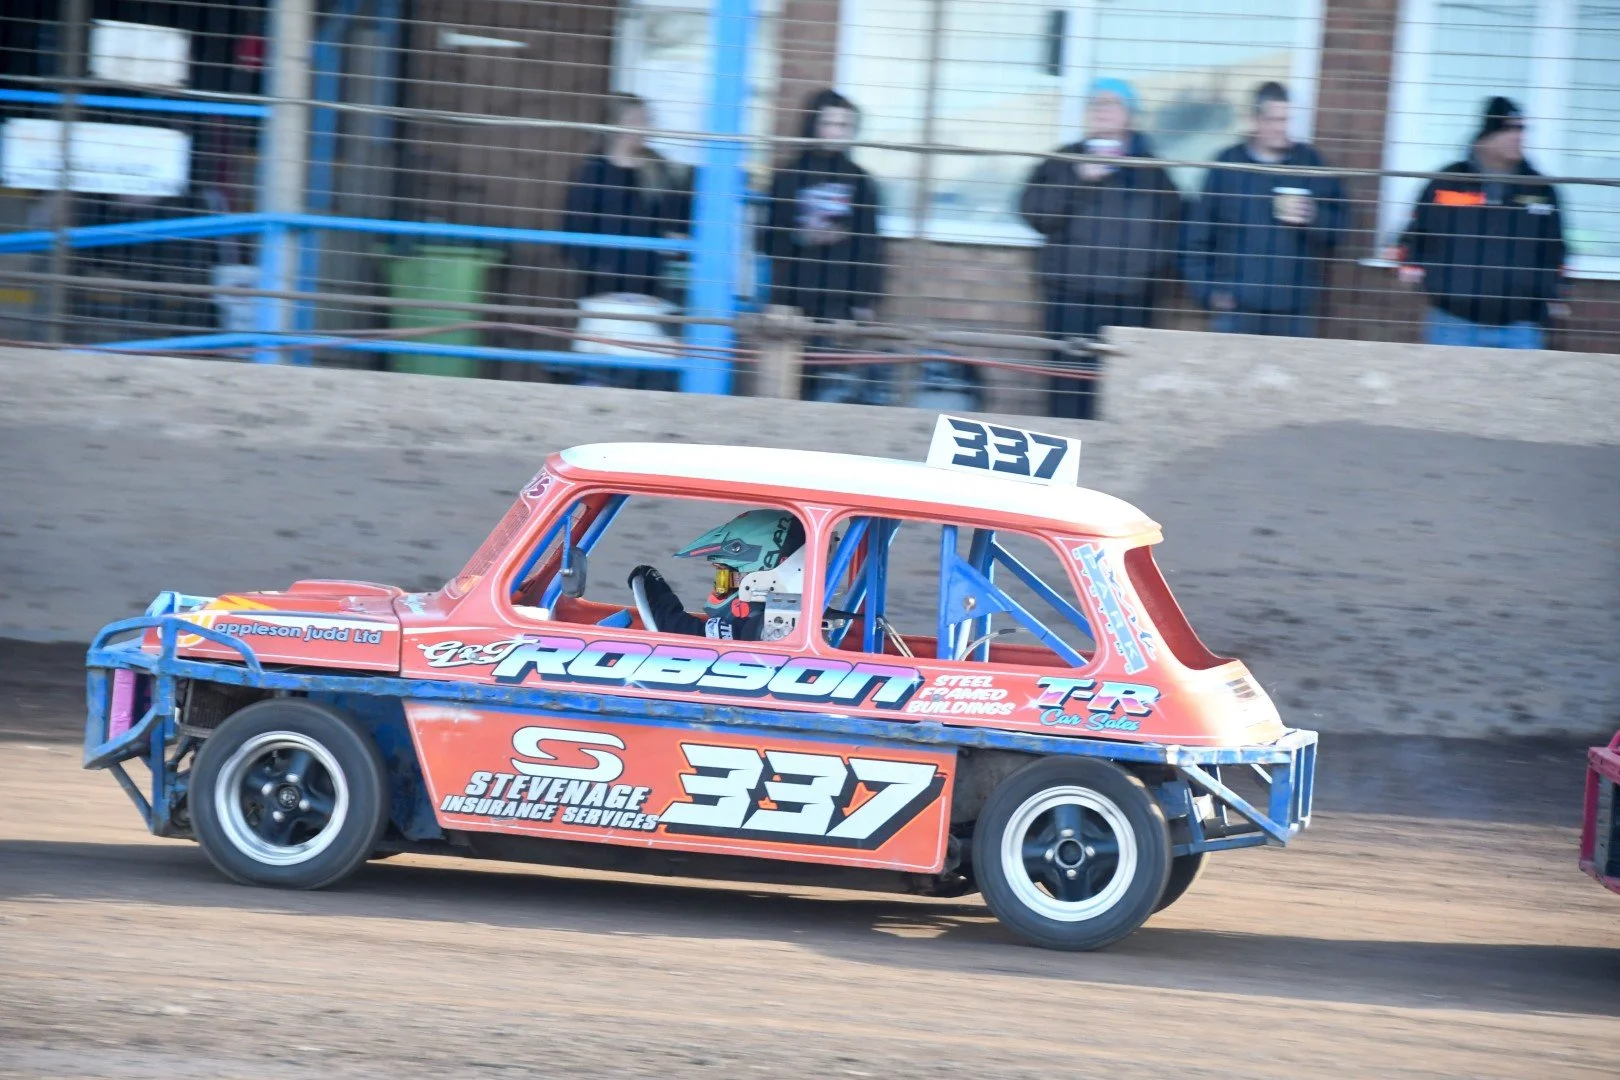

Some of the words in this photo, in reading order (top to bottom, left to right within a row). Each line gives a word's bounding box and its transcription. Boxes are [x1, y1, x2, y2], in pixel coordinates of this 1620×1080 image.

[948, 418, 1068, 480] 337
[214, 622, 301, 638] appleson
[304, 625, 348, 643] judd
[353, 630, 382, 645] Ltd
[917, 686, 1009, 700] FRAMED
[932, 674, 994, 688] STEEL
[1036, 676, 1162, 718] T-R
[905, 700, 1016, 716] BUILDINGS
[1038, 708, 1082, 727] Car
[1084, 712, 1140, 732] Sales
[464, 770, 653, 814] STEVENAGE
[658, 742, 943, 850] 337
[440, 794, 557, 824] INSURANCE
[561, 806, 661, 834] SERVICES
